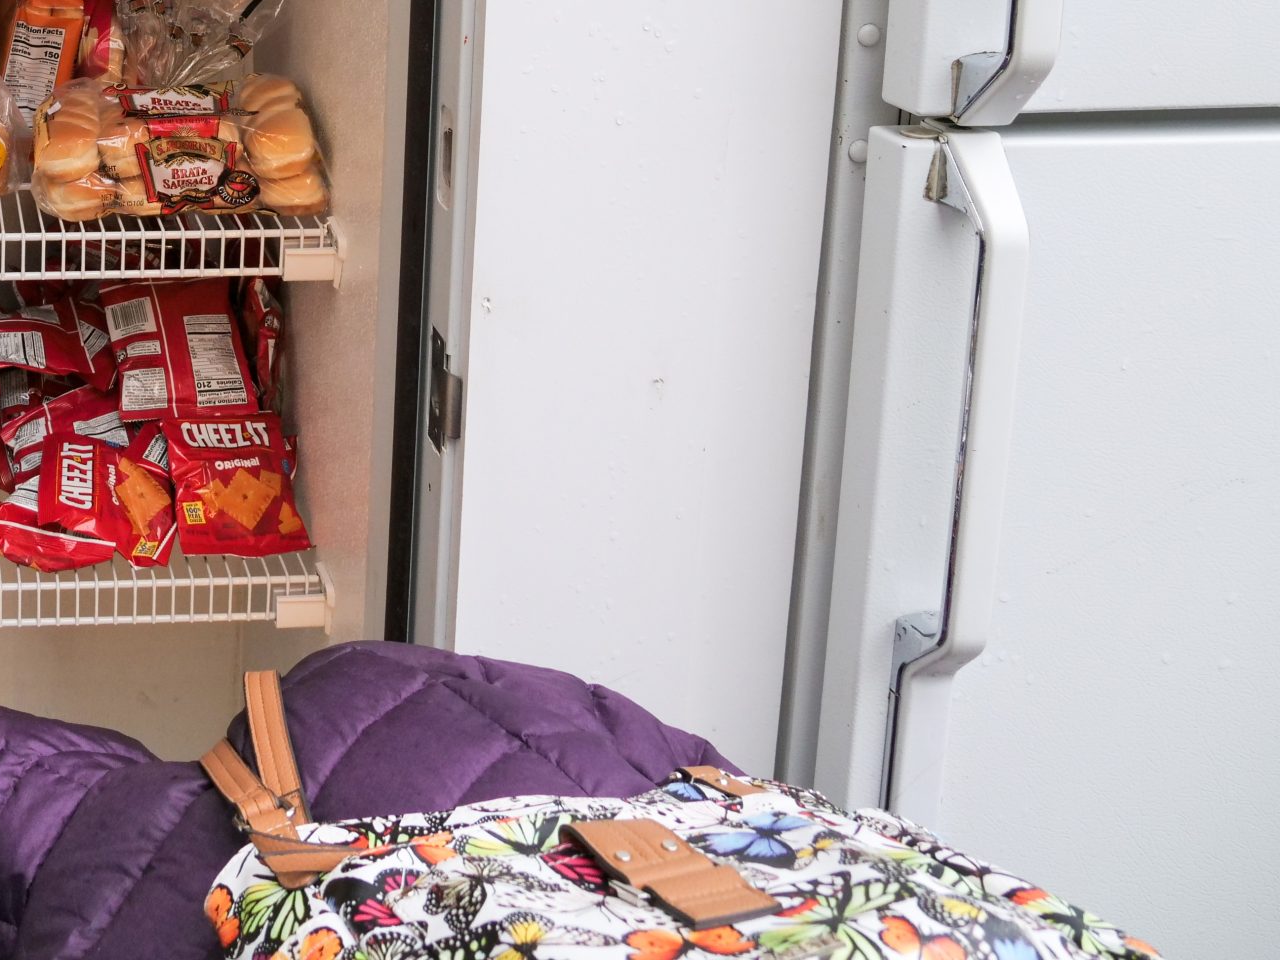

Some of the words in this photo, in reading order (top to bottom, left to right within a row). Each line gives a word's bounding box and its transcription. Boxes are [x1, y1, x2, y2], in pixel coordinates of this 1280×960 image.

[42, 28, 63, 36] Facts
[44, 50, 60, 59] 150
[151, 97, 191, 107] BRAT
[171, 166, 200, 180] BRAT
[162, 175, 215, 190] SAUSAGE
[218, 186, 251, 204] GRILLING
[196, 381, 212, 389] 210
